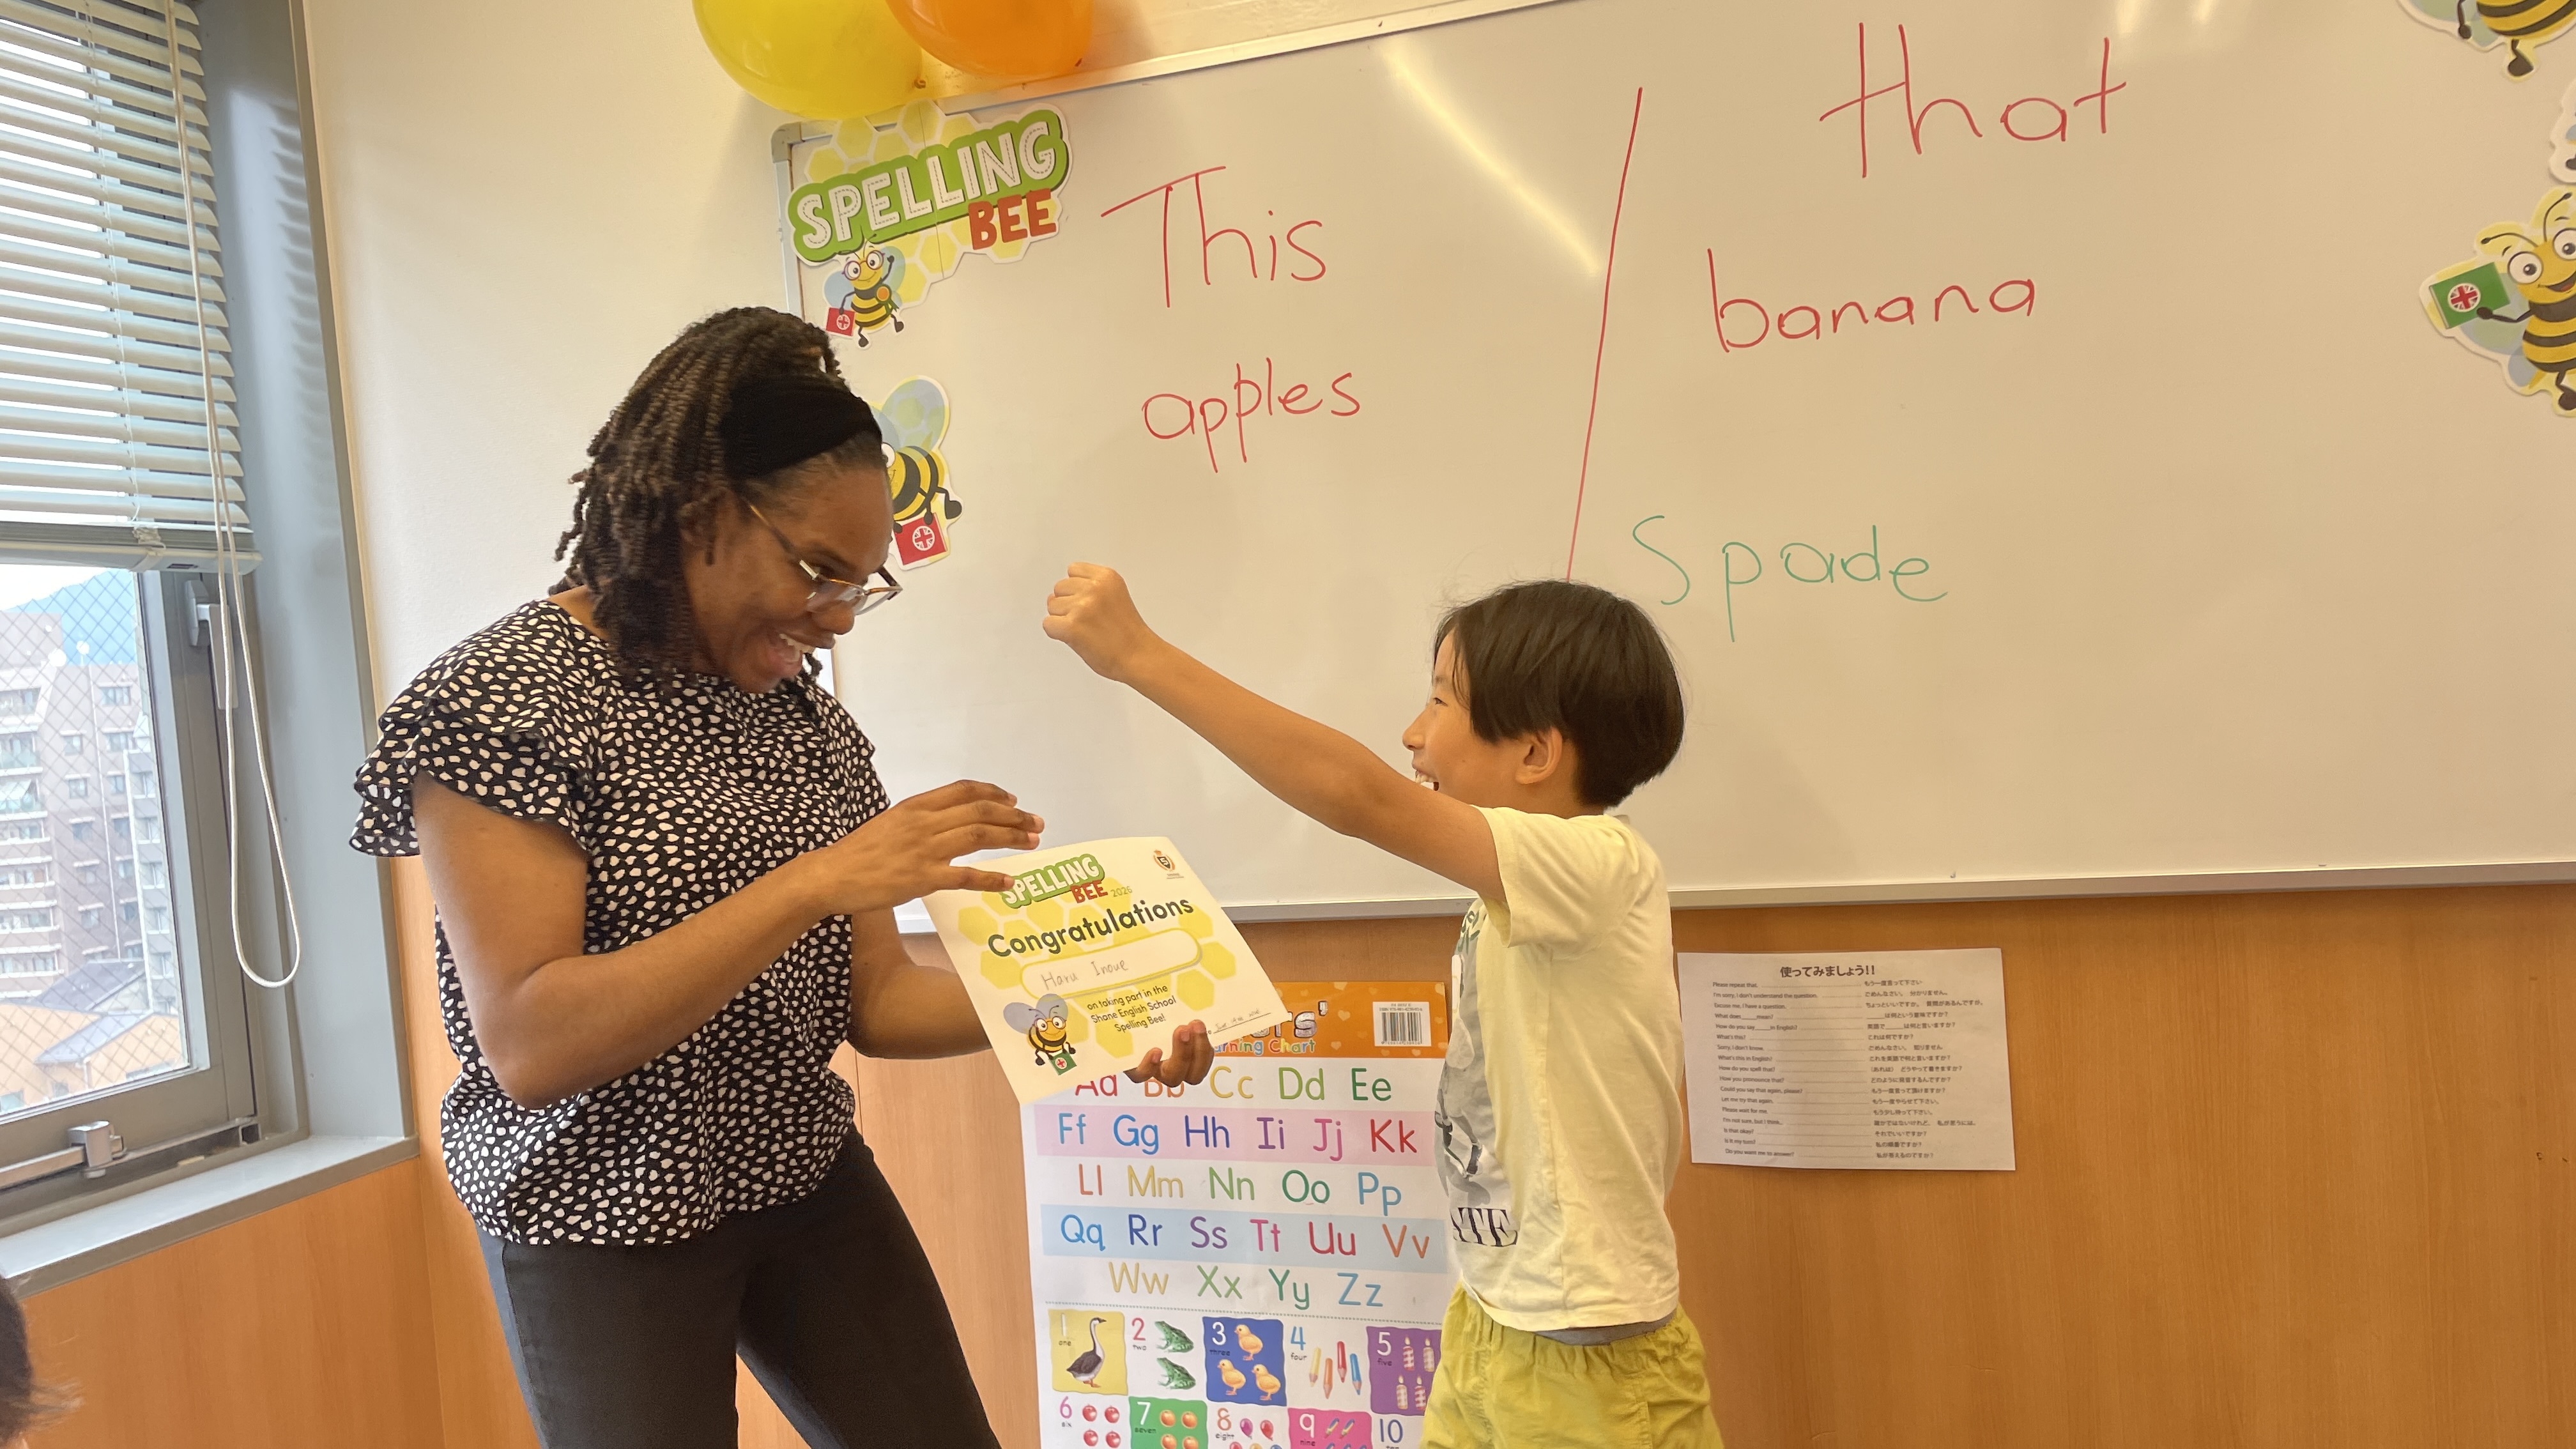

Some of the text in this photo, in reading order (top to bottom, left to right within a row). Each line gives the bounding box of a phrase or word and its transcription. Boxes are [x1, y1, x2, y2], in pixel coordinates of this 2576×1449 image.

[1820, 22, 2127, 178] that
[797, 121, 1055, 249] SPELLING
[968, 188, 1056, 250] BEE
[1101, 166, 1326, 307] This
[1707, 248, 2036, 353] banana
[1142, 357, 1360, 473] apples
[1002, 857, 1100, 904] SPELLING
[1070, 880, 1133, 903] BEE 2026
[988, 897, 1194, 956] Congratulations
[1041, 960, 1128, 990] Haru Inoue
[1091, 995, 1176, 1023] Shane English School
[1098, 997, 1124, 1007] taking
[1126, 992, 1142, 1004] part
[1153, 985, 1168, 994] the
[1114, 1013, 1166, 1032] Spelling Bee!
[1269, 1038, 1315, 1054] Chart
[1209, 1066, 1254, 1099] Cc
[1279, 1067, 1324, 1100] Dd
[1352, 1068, 1392, 1101] Ee
[1059, 1113, 1417, 1162] Ff Gg Hh Ii Jj Kk
[1078, 1164, 1401, 1216] Ll Mm Nn Oo Pp
[1061, 1214, 1430, 1259] Qq Rr Ss Tt Uu Vv
[1108, 1261, 1383, 1310] Ww Xx Yy Zz
[1061, 1313, 1066, 1337] 1
[1131, 1317, 1146, 1341] 2
[1212, 1321, 1226, 1346] 3
[1291, 1326, 1306, 1350] 4
[1377, 1331, 1392, 1356] 5
[1291, 1353, 1307, 1361] four
[1059, 1396, 1072, 1419] 6
[1137, 1402, 1151, 1425] 7
[1217, 1407, 1232, 1430] 8
[1300, 1413, 1315, 1438] 9
[1380, 1418, 1403, 1443] 10
